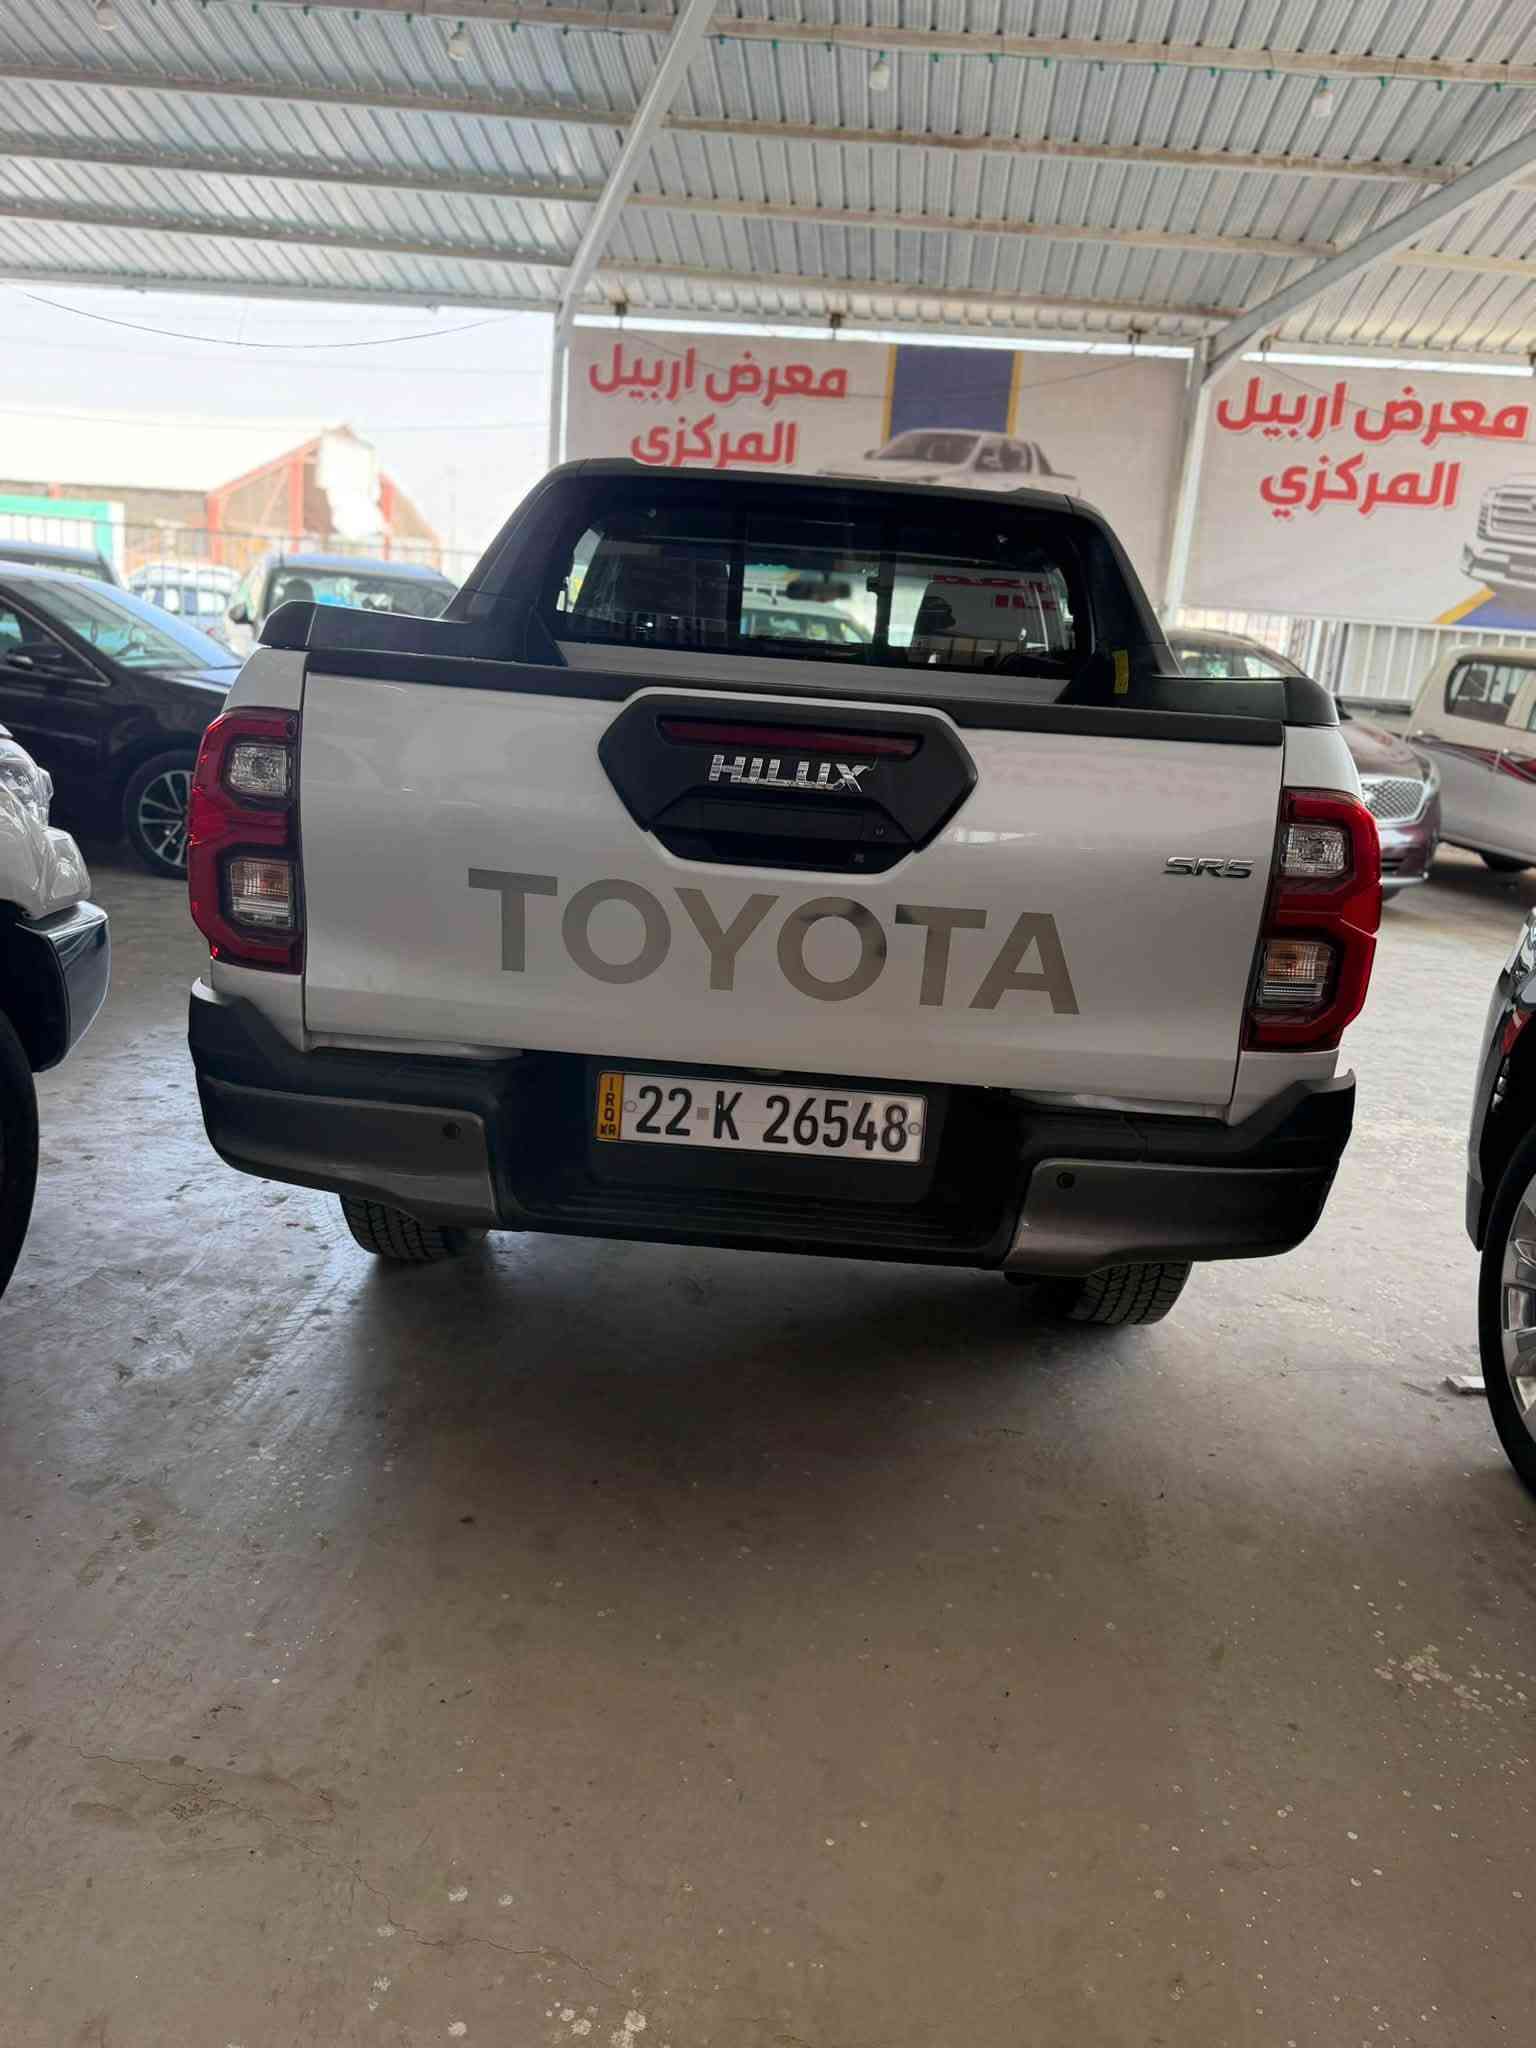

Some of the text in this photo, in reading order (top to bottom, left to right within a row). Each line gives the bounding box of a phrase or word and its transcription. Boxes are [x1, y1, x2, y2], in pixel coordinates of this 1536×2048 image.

[590, 344, 848, 406] معرض اربيل
[1217, 376, 1530, 446] معرض اربيل
[1260, 453, 1461, 518] المركزي
[709, 754, 868, 793] HILUX
[1164, 856, 1254, 878] SR5
[468, 867, 1080, 1016] TOYOTA
[635, 1085, 909, 1153] 22 K 26548
